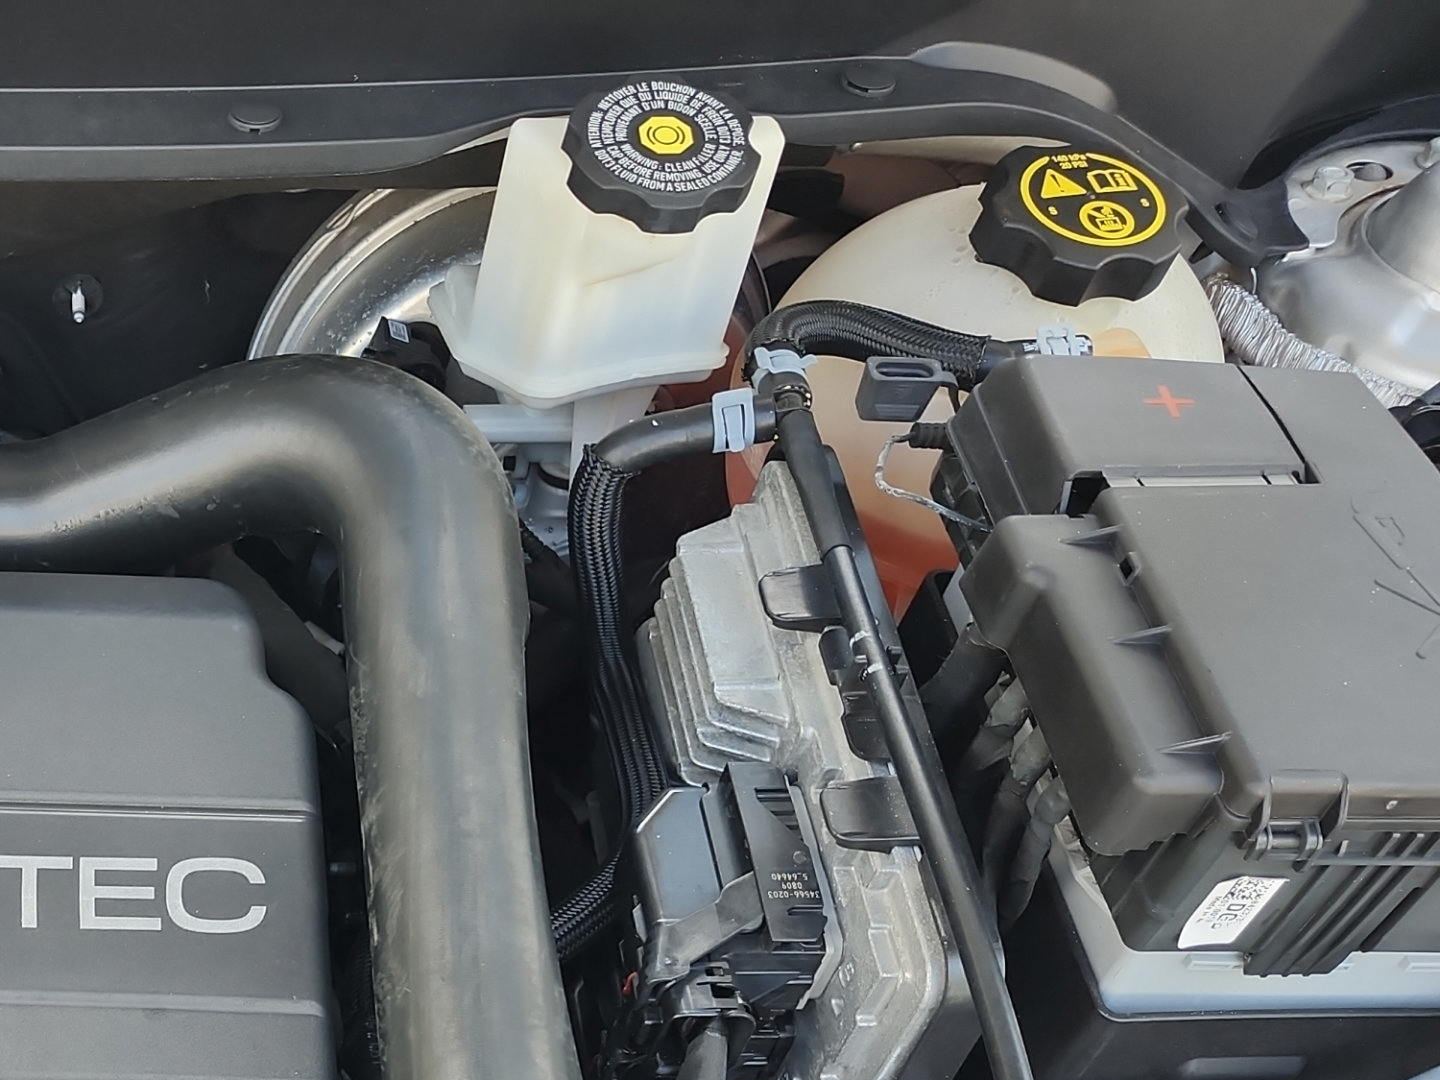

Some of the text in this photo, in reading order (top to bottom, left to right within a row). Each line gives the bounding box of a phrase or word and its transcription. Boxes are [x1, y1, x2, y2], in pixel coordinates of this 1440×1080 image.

[597, 85, 637, 111] NETTOYER
[636, 82, 650, 91] LE
[651, 81, 696, 96] BOUCHON
[695, 91, 725, 110] AVANT
[719, 108, 734, 120] LA
[619, 95, 639, 108] QUE
[637, 91, 652, 101] DU
[654, 91, 690, 104] LIQUIDE
[689, 98, 704, 110] DE
[701, 106, 725, 126] FREIN
[615, 105, 643, 142] PROVENANT
[641, 100, 665, 111] D'UN
[667, 100, 697, 117] BIDON
[606, 144, 731, 181] CAP BEFORE REMOVING. USE ONLY
[664, 159, 696, 172] CLEAN
[692, 143, 717, 165] FILLER
[1051, 154, 1068, 163] 140
[1059, 161, 1088, 170] 20 PSI
[609, 164, 638, 183] FLUID
[636, 177, 665, 191] FROM
[665, 181, 674, 192] A
[674, 177, 711, 192] SEALED
[1047, 206, 1058, 216] S
[1139, 198, 1150, 208] S
